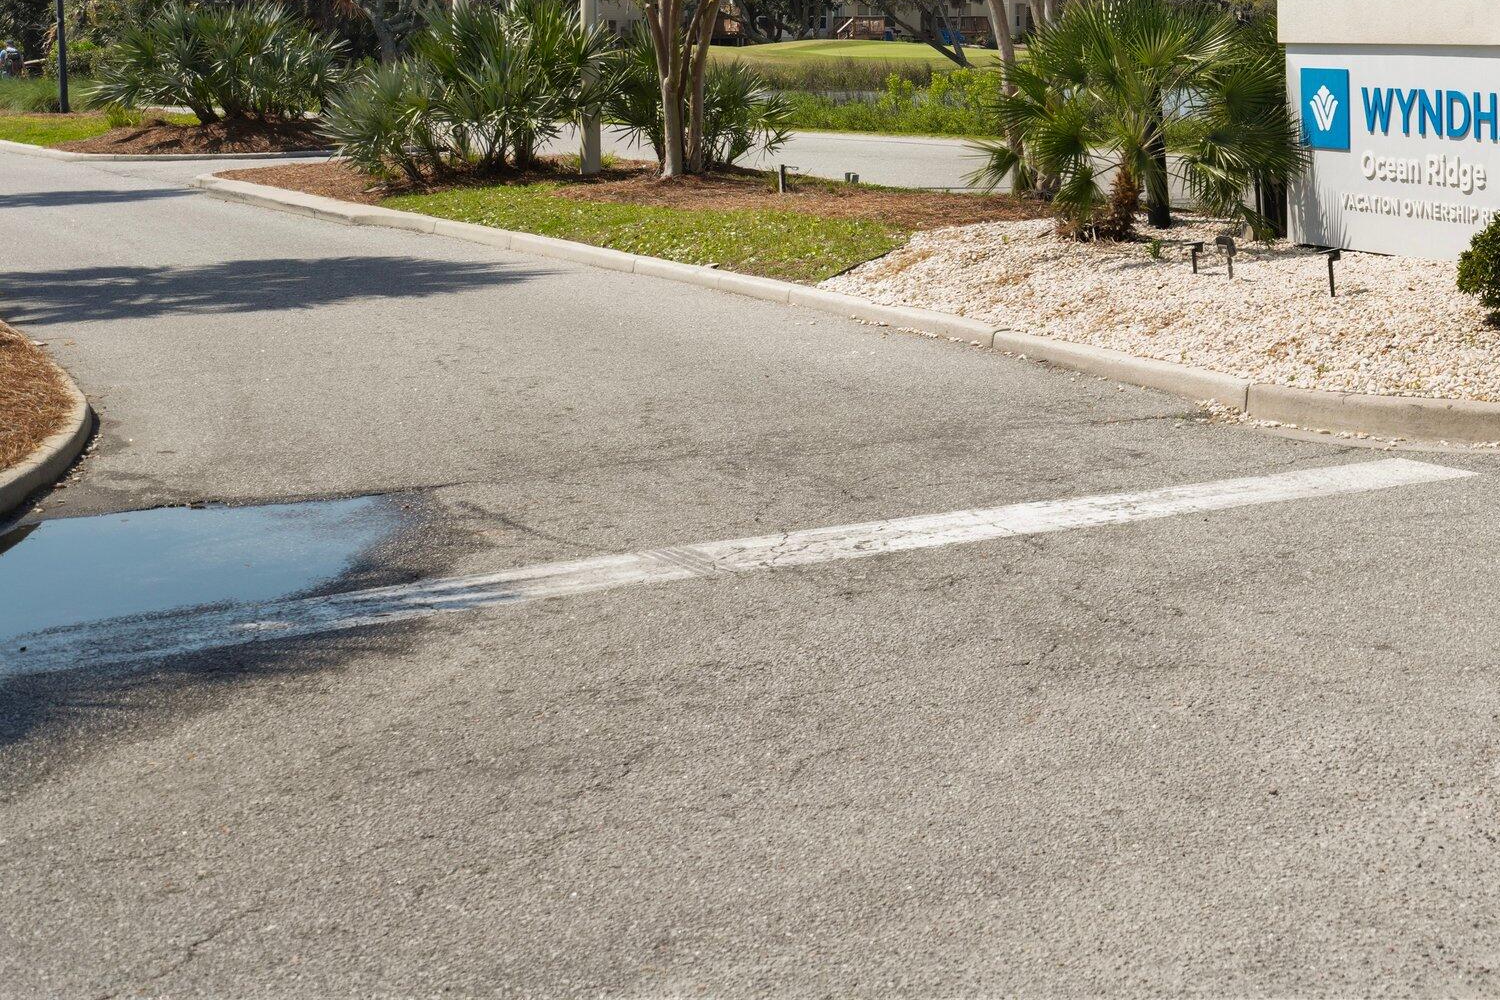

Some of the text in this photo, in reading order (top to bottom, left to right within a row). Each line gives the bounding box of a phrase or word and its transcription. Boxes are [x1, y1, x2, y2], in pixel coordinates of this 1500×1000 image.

[1361, 150, 1487, 195] Ocean Ridge
[1341, 192, 1400, 217] VACATION
[1404, 199, 1479, 225] OWNERSHIP
